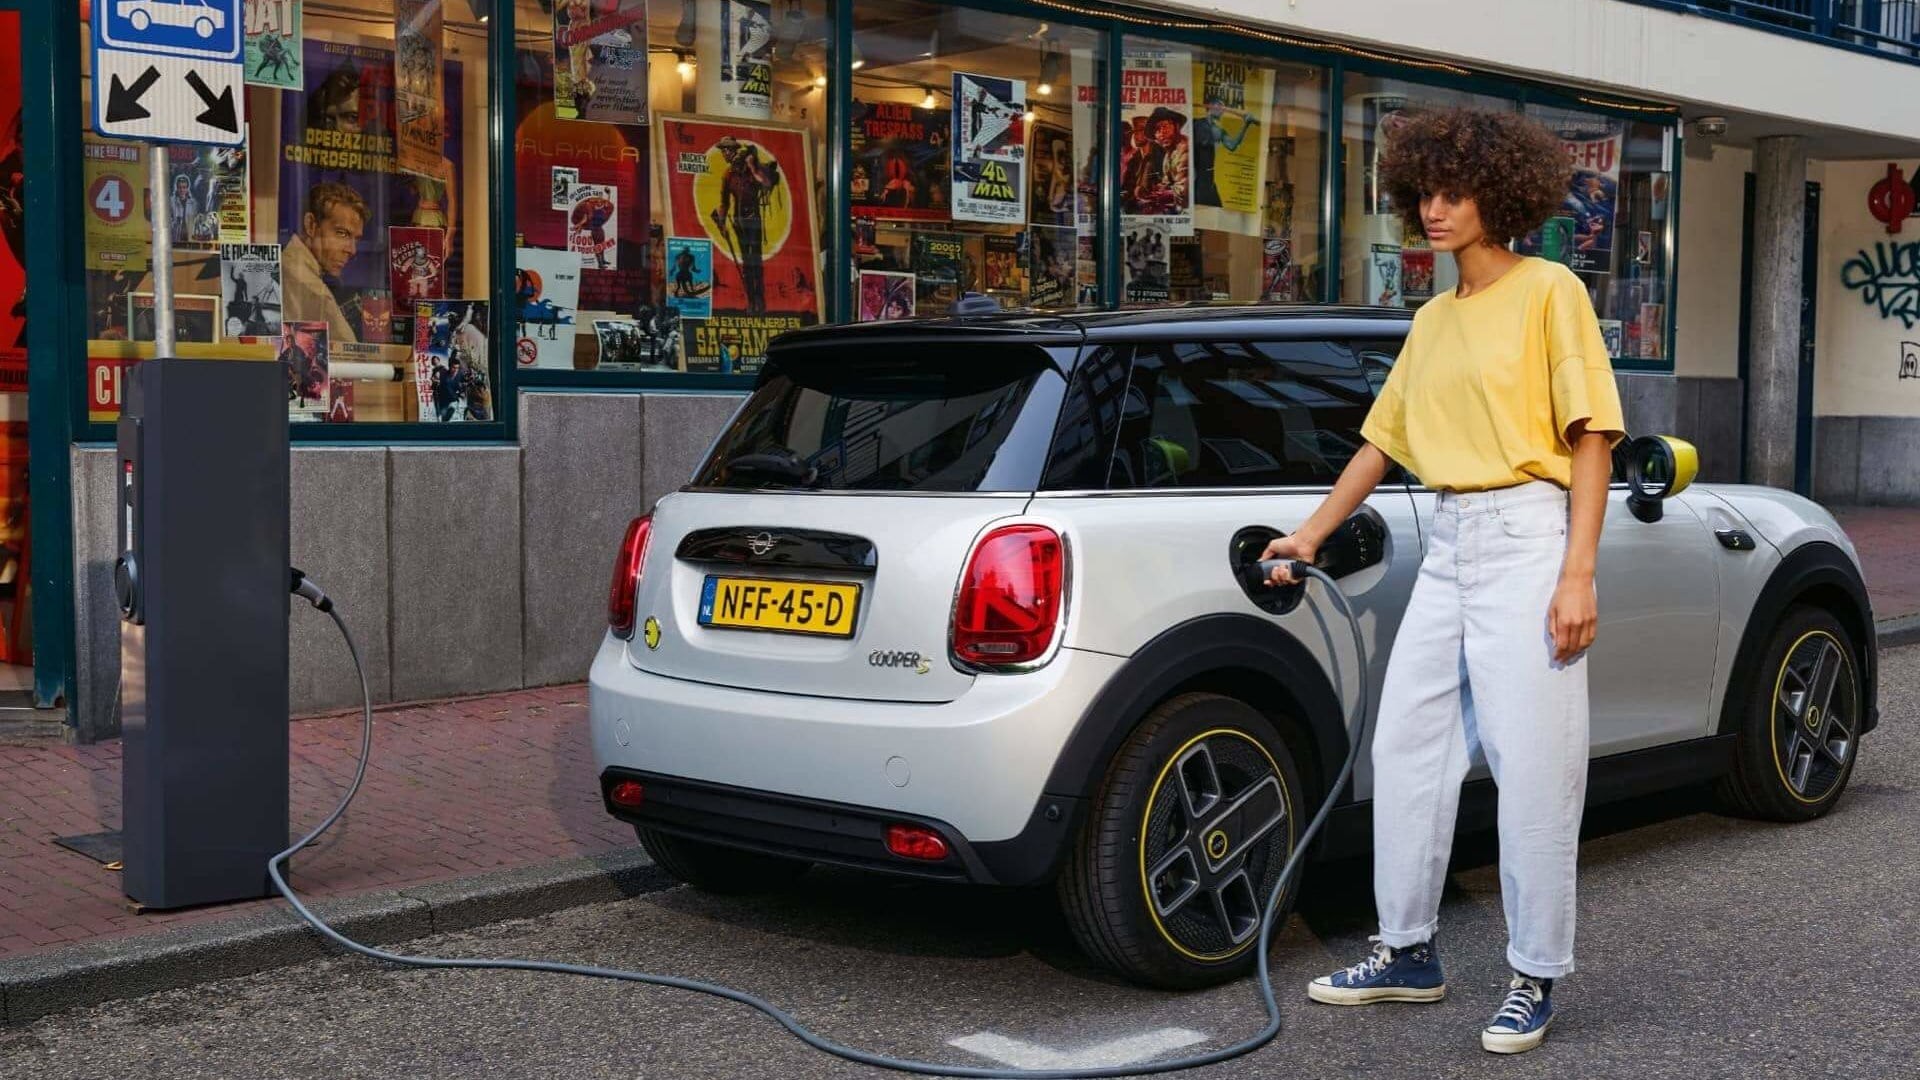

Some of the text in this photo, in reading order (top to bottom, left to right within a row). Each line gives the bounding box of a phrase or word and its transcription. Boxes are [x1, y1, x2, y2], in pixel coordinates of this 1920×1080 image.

[1139, 88, 1186, 104] MARIA
[876, 102, 912, 120] ALIEN
[864, 120, 925, 140] TRESPASS
[306, 128, 392, 153] OPERAZIONE
[96, 180, 124, 217] 4
[974, 182, 1016, 199] MAN
[222, 244, 231, 260] LE
[720, 316, 786, 328] EXTRANJERO
[788, 318, 800, 329] EN
[95, 365, 121, 405] CI
[702, 605, 712, 616] NL
[721, 584, 843, 627] NFF-45-D
[869, 649, 919, 668] COOPER
